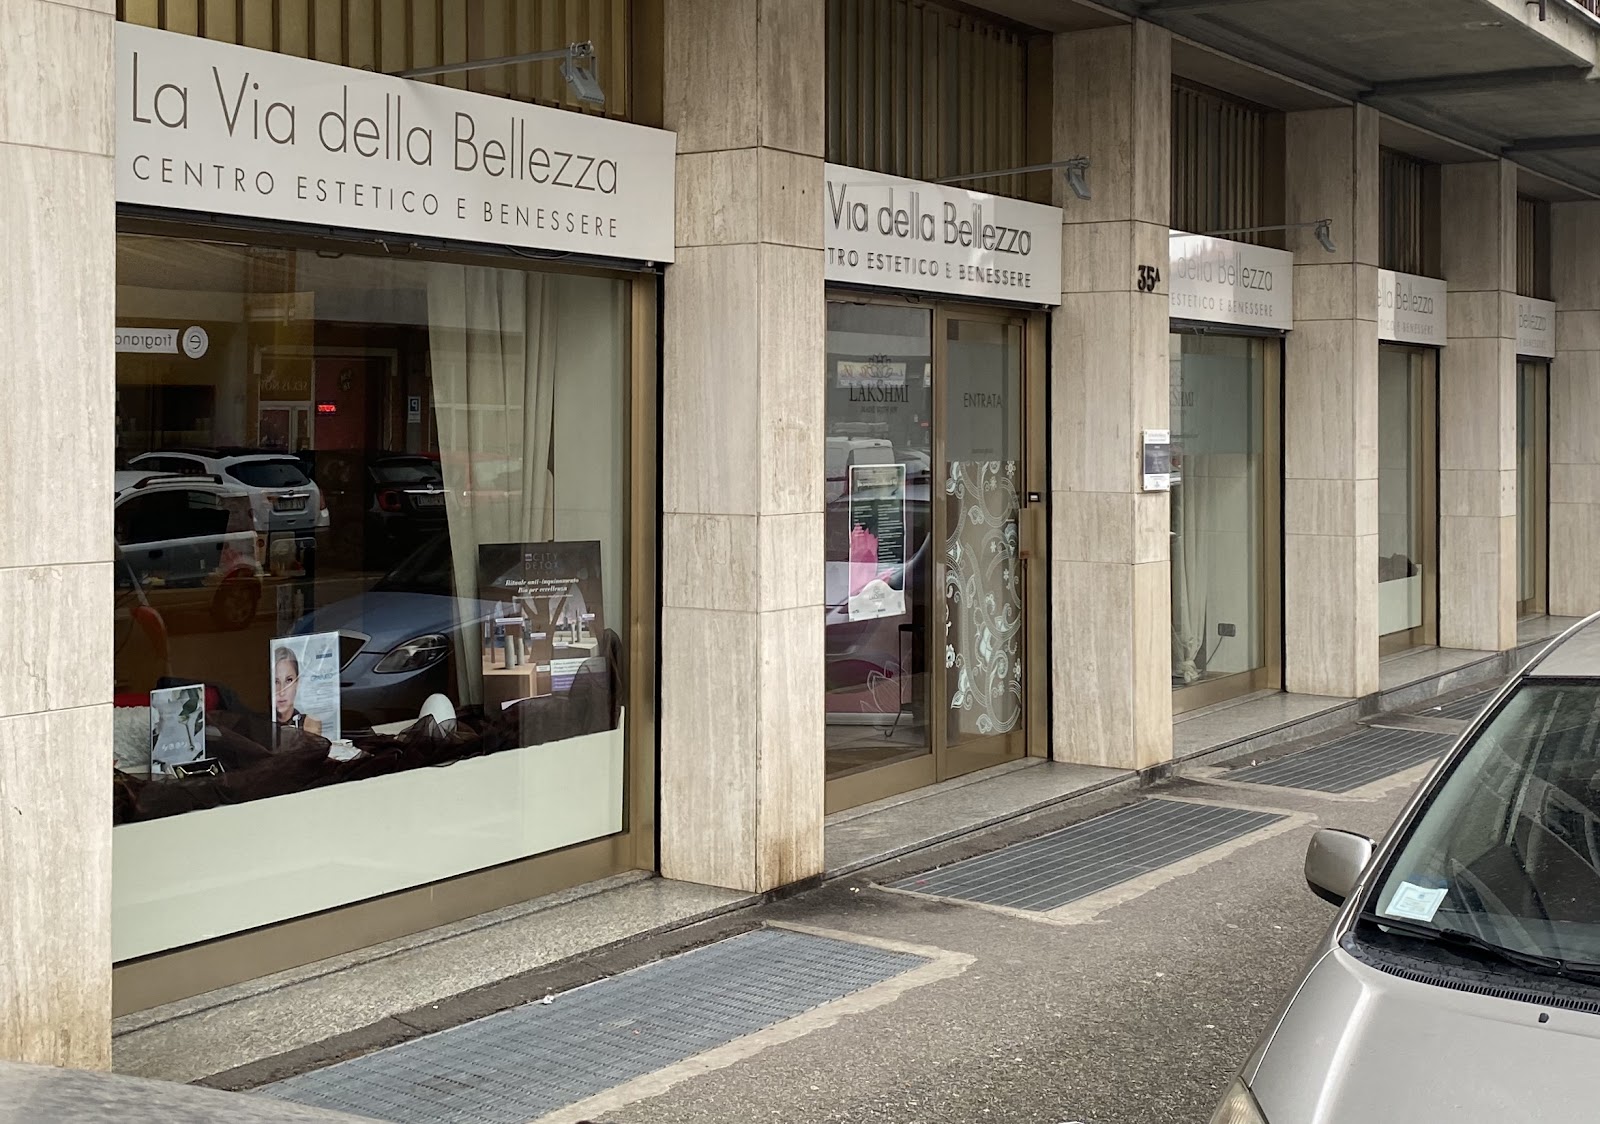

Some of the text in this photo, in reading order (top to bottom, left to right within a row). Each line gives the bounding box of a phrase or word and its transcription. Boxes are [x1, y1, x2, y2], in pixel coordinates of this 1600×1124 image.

[131, 51, 618, 195] La Via della Bellezza
[132, 154, 618, 239] CENTRO ESTETICO E BENESSERE
[827, 180, 1032, 257] Via della Bellezza
[867, 252, 939, 277] ESTETICO
[945, 262, 952, 279] E
[959, 264, 1032, 288] BENESSERE
[1177, 240, 1273, 292] della Bellezza
[1171, 293, 1273, 317] ESTETICO E BENESSERE
[1396, 282, 1434, 314] Bellezza
[849, 379, 909, 402] LAKSHMI
[963, 392, 1002, 409] ENTRATA
[533, 552, 559, 562] CITY
